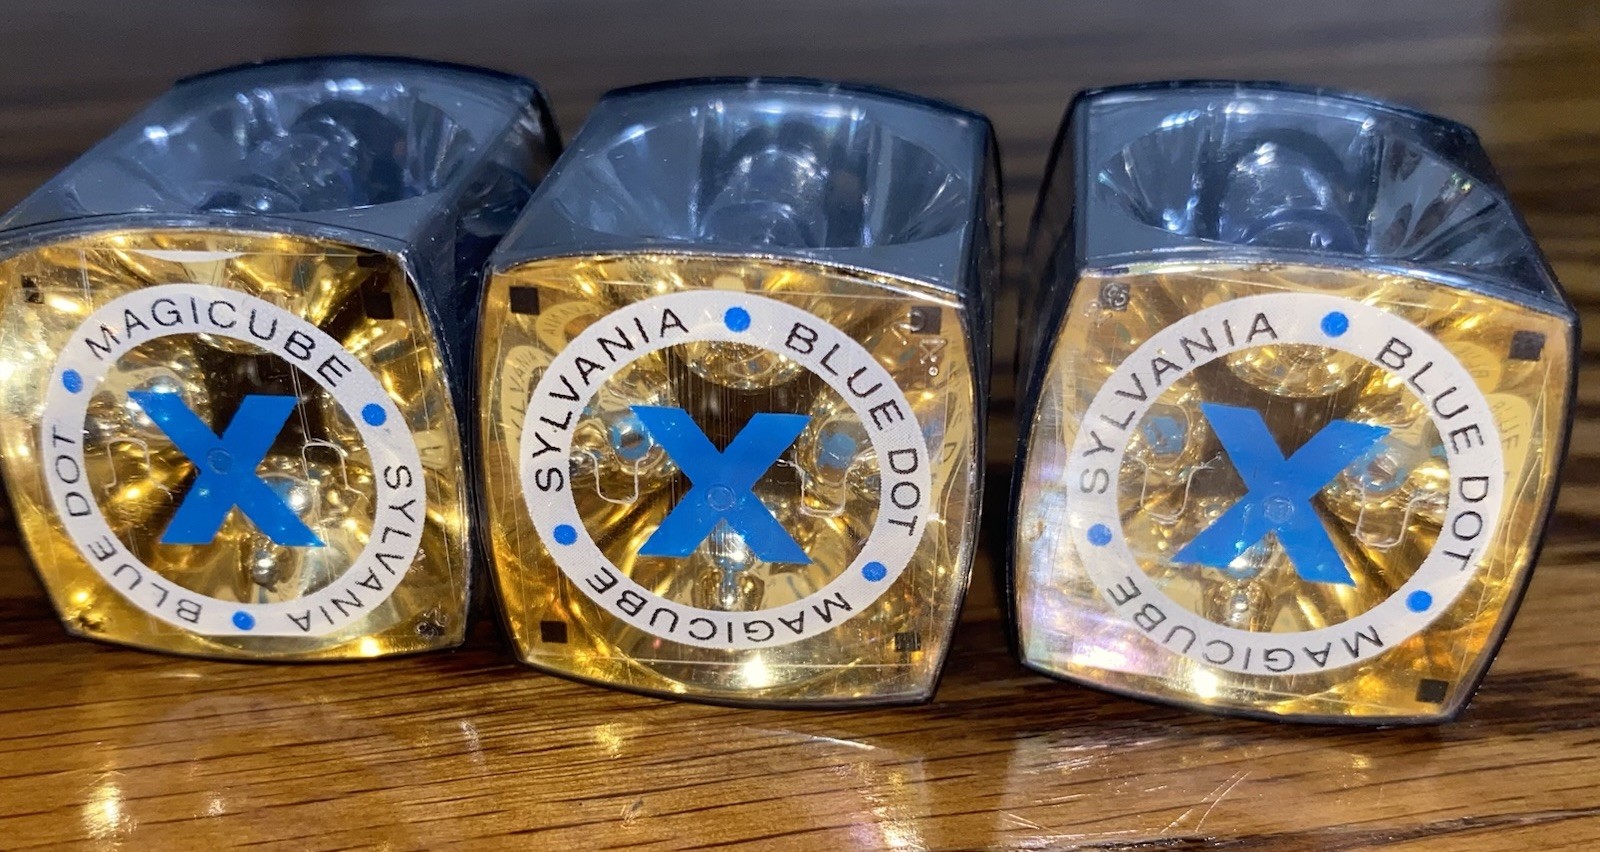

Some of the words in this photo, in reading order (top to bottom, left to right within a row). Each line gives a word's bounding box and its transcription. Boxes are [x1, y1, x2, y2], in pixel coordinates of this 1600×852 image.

[84, 297, 352, 389] MAGICUBE
[534, 308, 689, 493] SYLVANIA
[1081, 312, 1279, 495] SYLVANIA
[52, 425, 92, 517] DOT
[785, 322, 905, 431] BLUE
[887, 448, 920, 536] DOT
[1375, 336, 1484, 456] BLUE
[1443, 475, 1490, 572] DOT
[90, 534, 203, 624] BLUE
[286, 464, 416, 632] SYLVANIA
[585, 565, 853, 644] MAGICUBE
[1107, 574, 1384, 672] MAGICUBE
